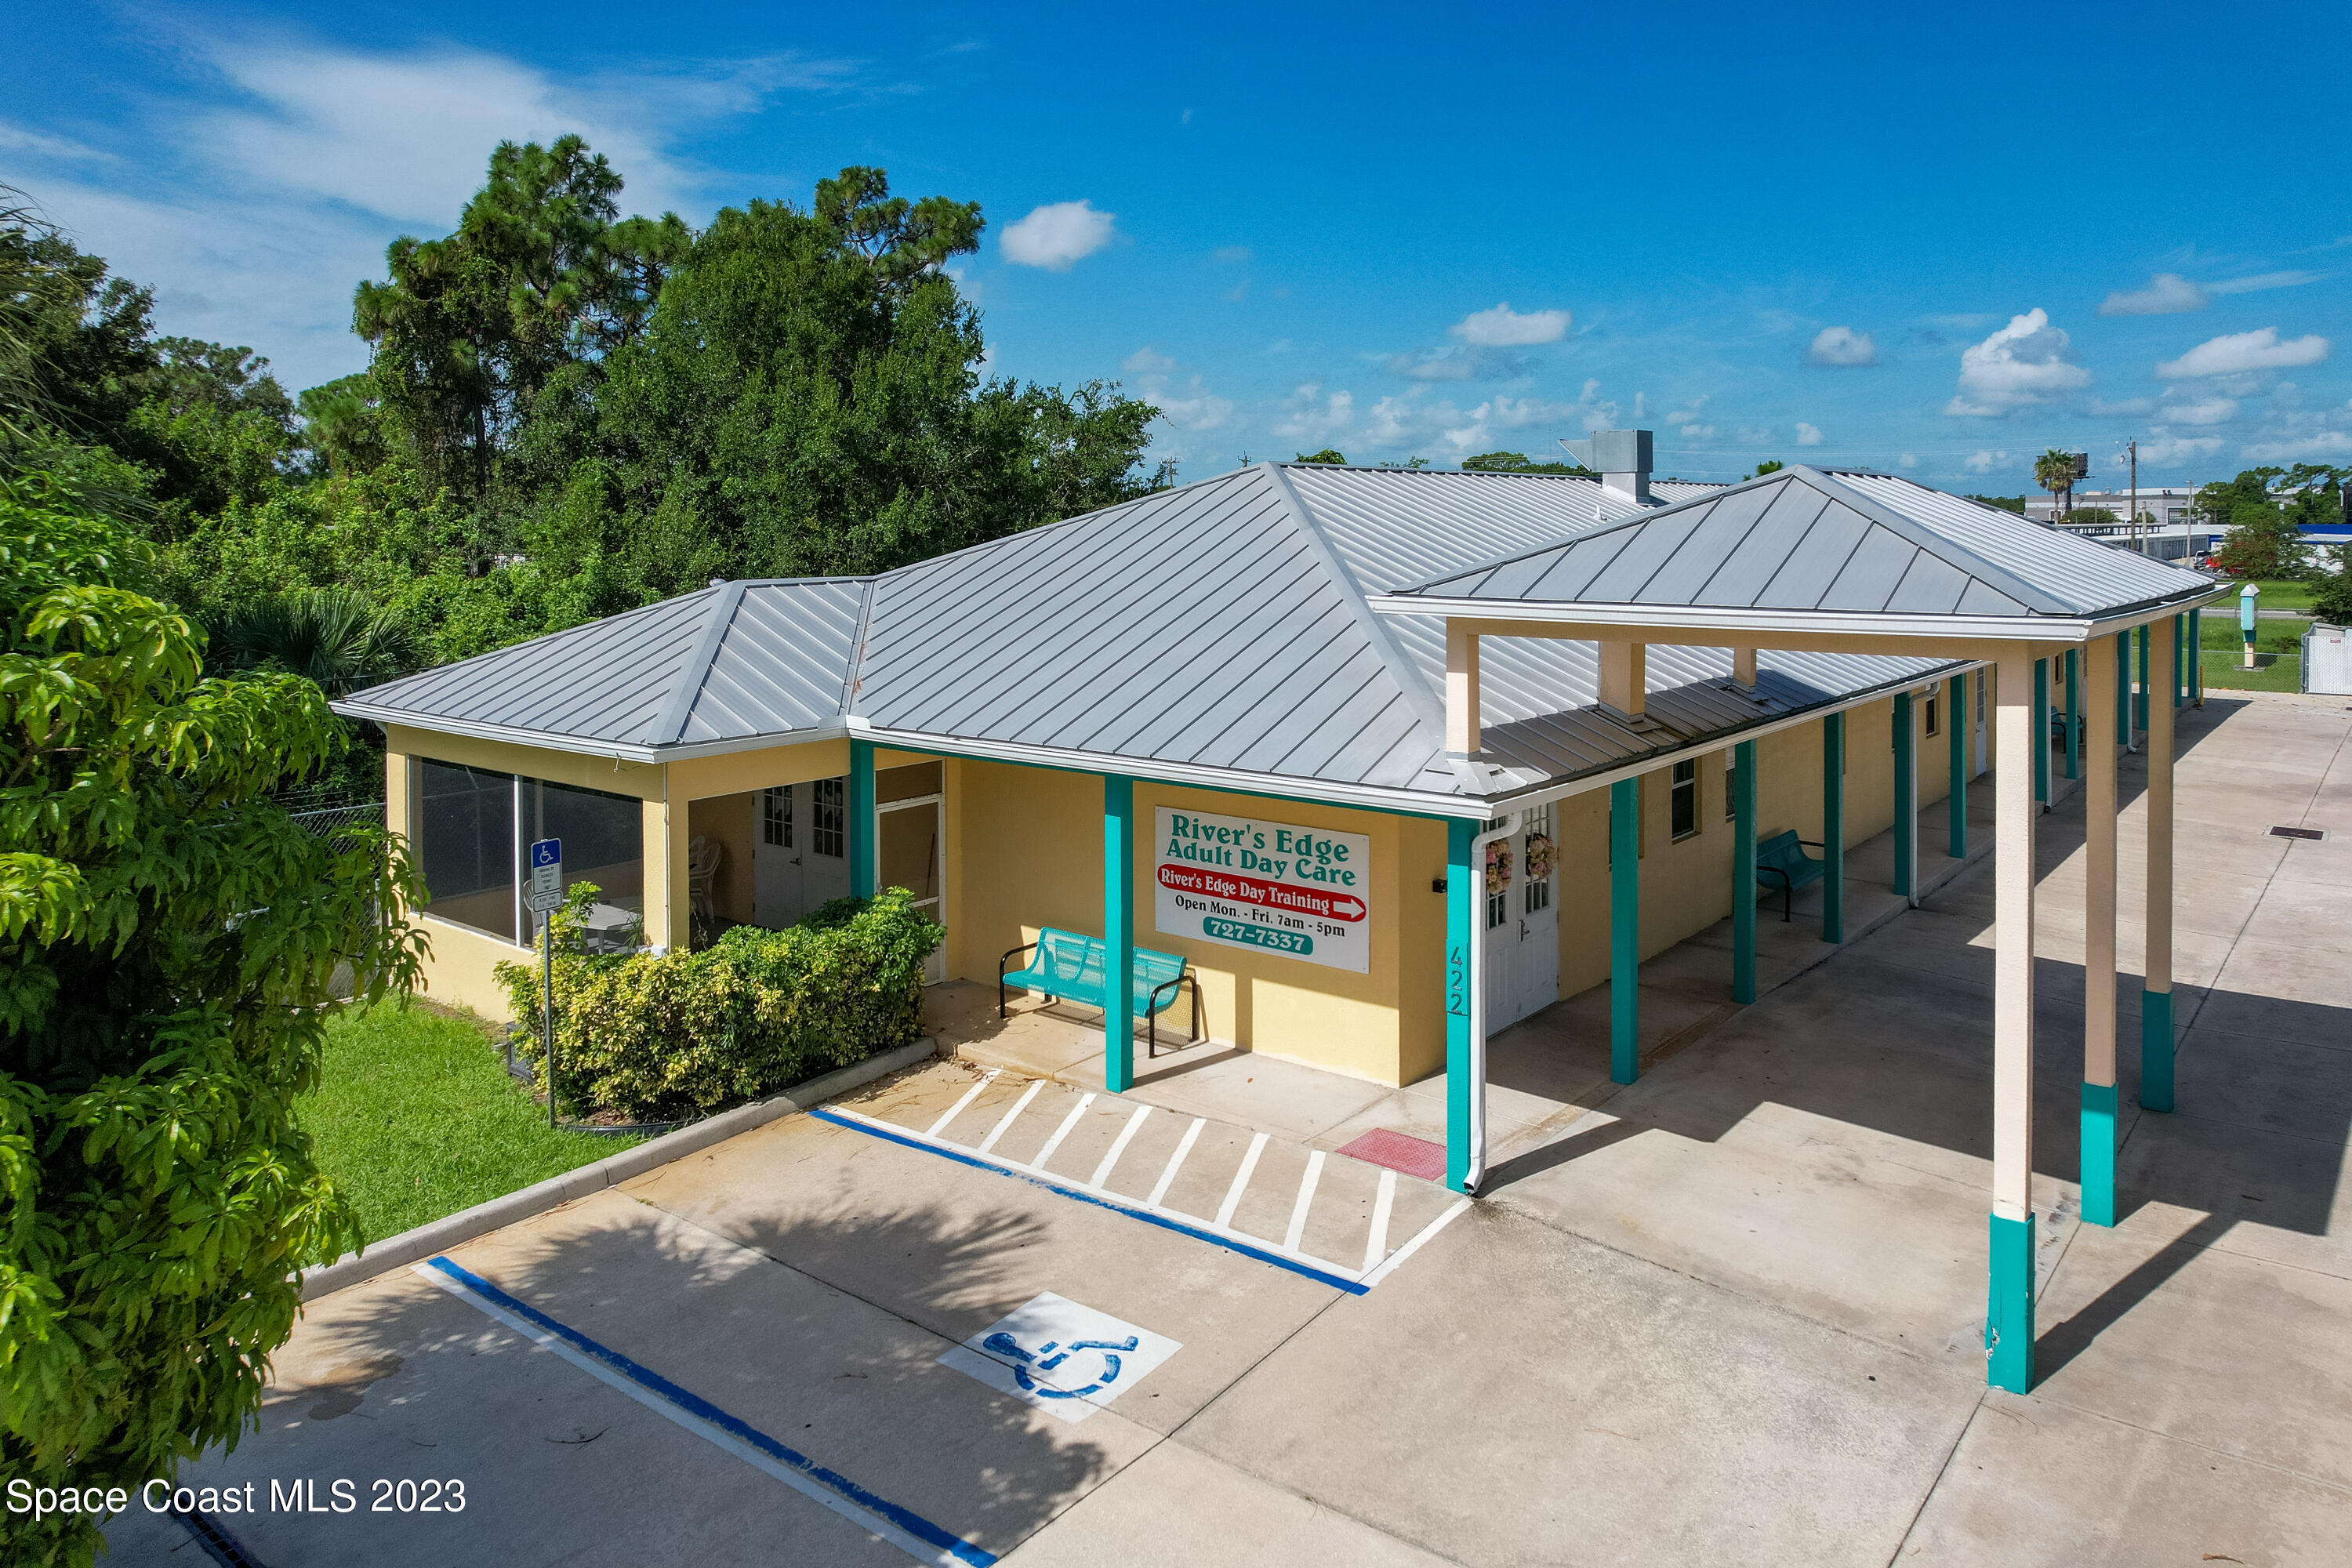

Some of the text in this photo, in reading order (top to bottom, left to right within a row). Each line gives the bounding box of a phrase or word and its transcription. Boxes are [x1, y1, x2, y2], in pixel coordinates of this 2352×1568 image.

[1167, 839, 1356, 886] Adult Day Care
[1172, 814, 1348, 865] River's Edge
[1161, 868, 1329, 915] River's Edge Day Training
[1175, 895, 1207, 911] Open
[1210, 902, 1240, 918] Mon.
[1252, 909, 1273, 924] Fri.
[1277, 914, 1305, 930] 7am
[1317, 922, 1345, 937] 5pm
[1210, 920, 1305, 952] 727-7337
[1450, 946, 1463, 1014] 422
